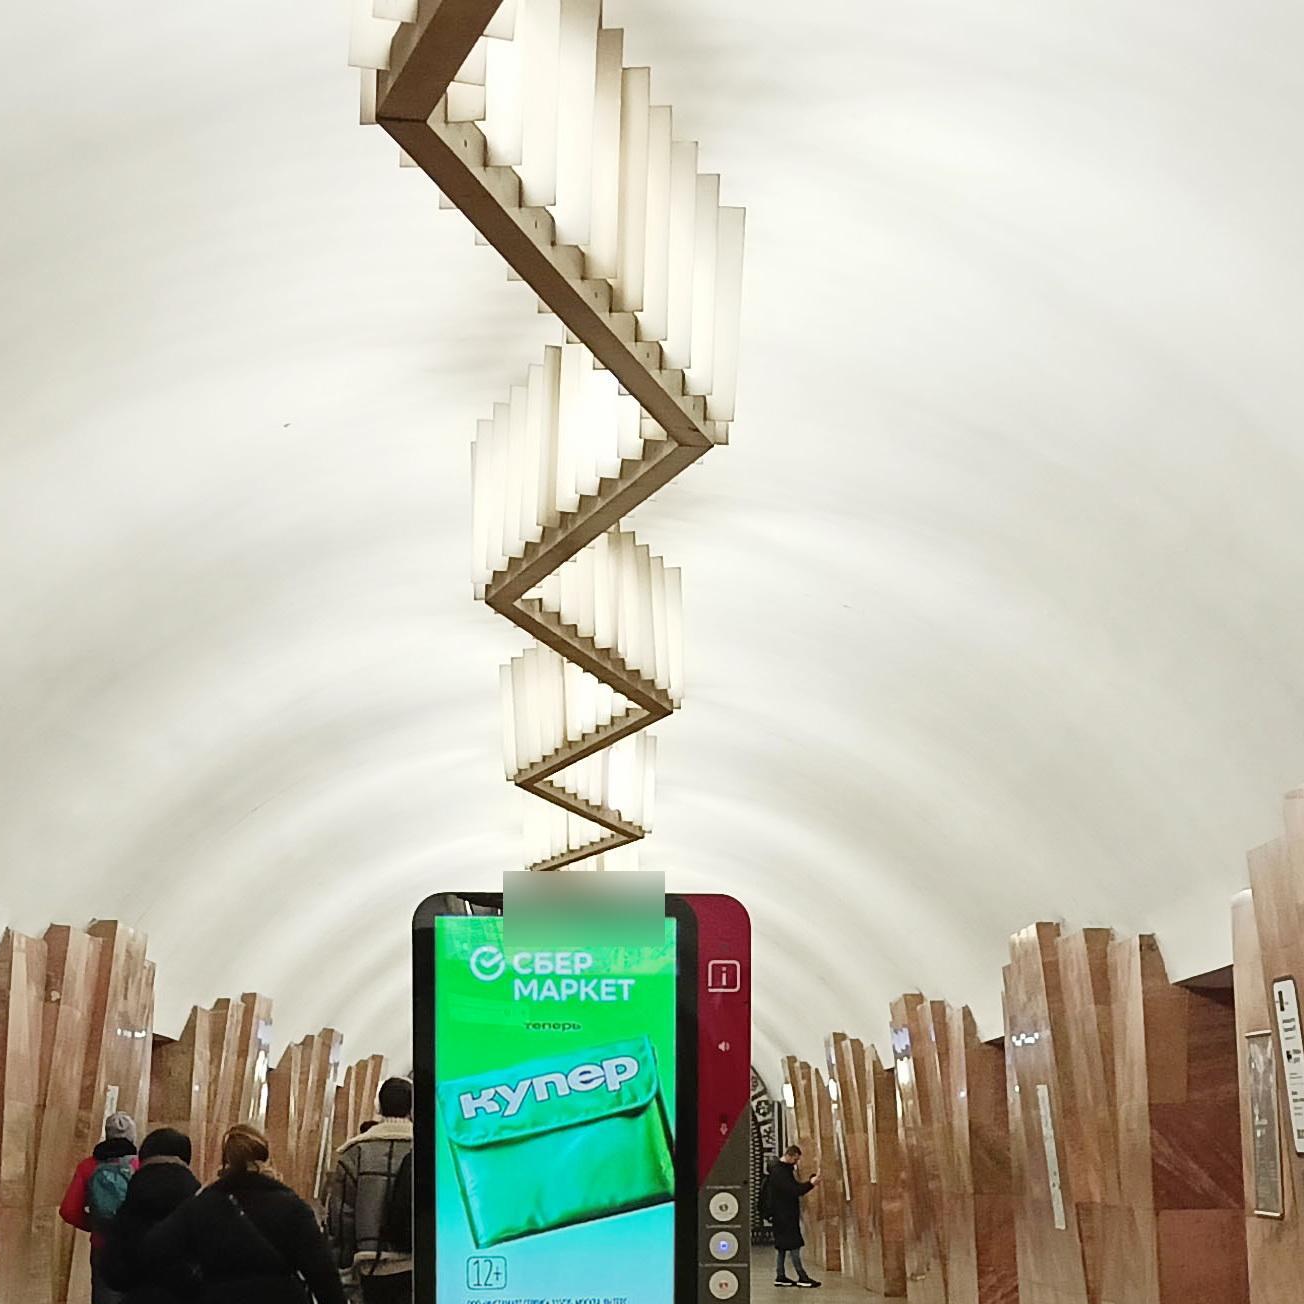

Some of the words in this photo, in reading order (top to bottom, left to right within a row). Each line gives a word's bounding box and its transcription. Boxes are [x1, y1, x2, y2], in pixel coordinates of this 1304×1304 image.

[512, 951, 594, 976] СБЕР
[513, 978, 636, 1001] МАРКЕТ
[524, 1021, 582, 1032] теперь
[459, 1056, 639, 1119] купер
[472, 1259, 503, 1287] 12+
